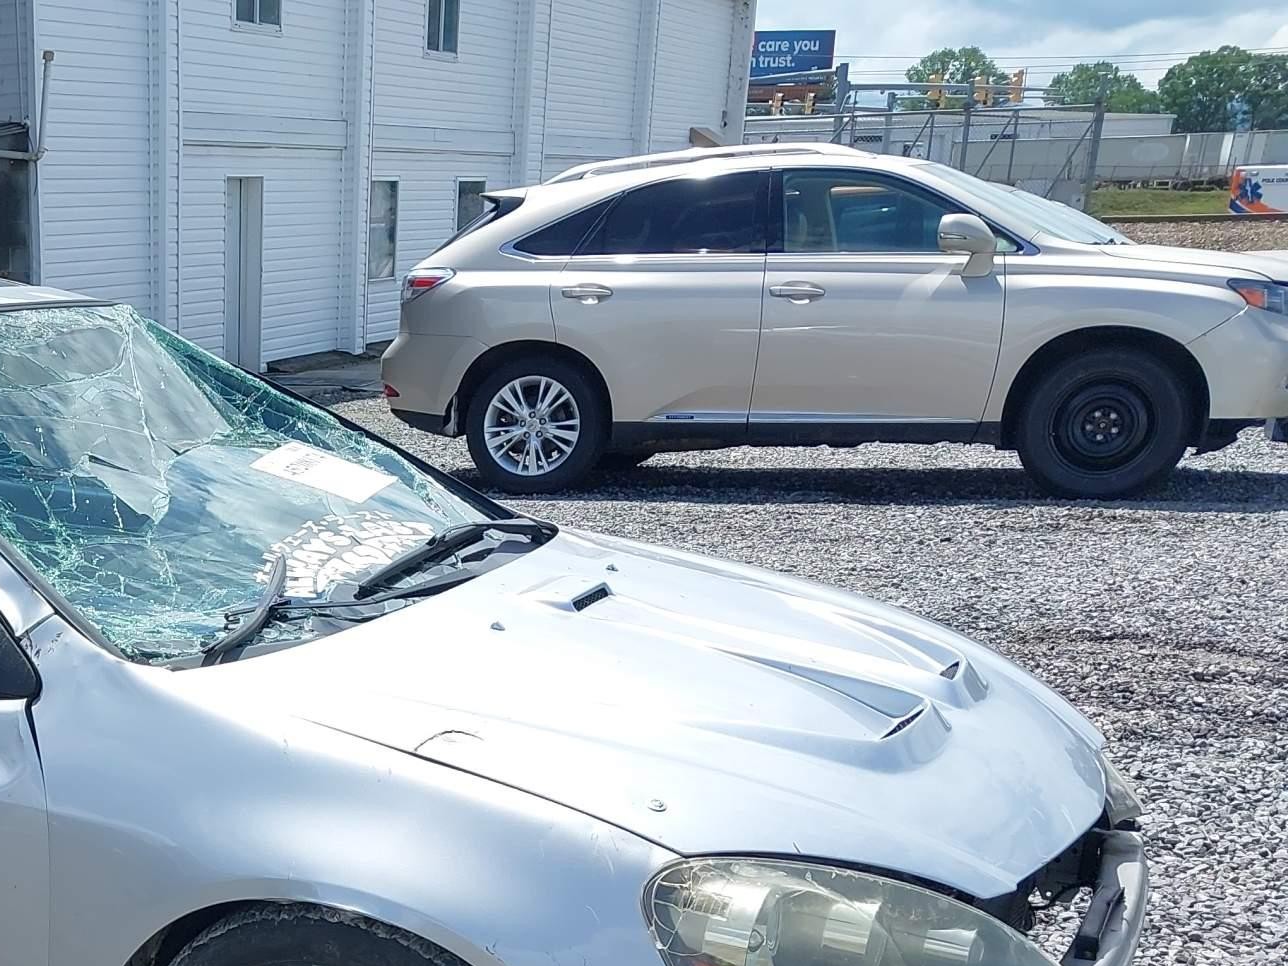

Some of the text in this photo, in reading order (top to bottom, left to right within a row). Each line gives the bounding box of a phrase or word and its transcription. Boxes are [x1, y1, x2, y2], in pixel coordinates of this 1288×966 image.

[758, 40, 820, 55] care you
[758, 54, 796, 68] trust.
